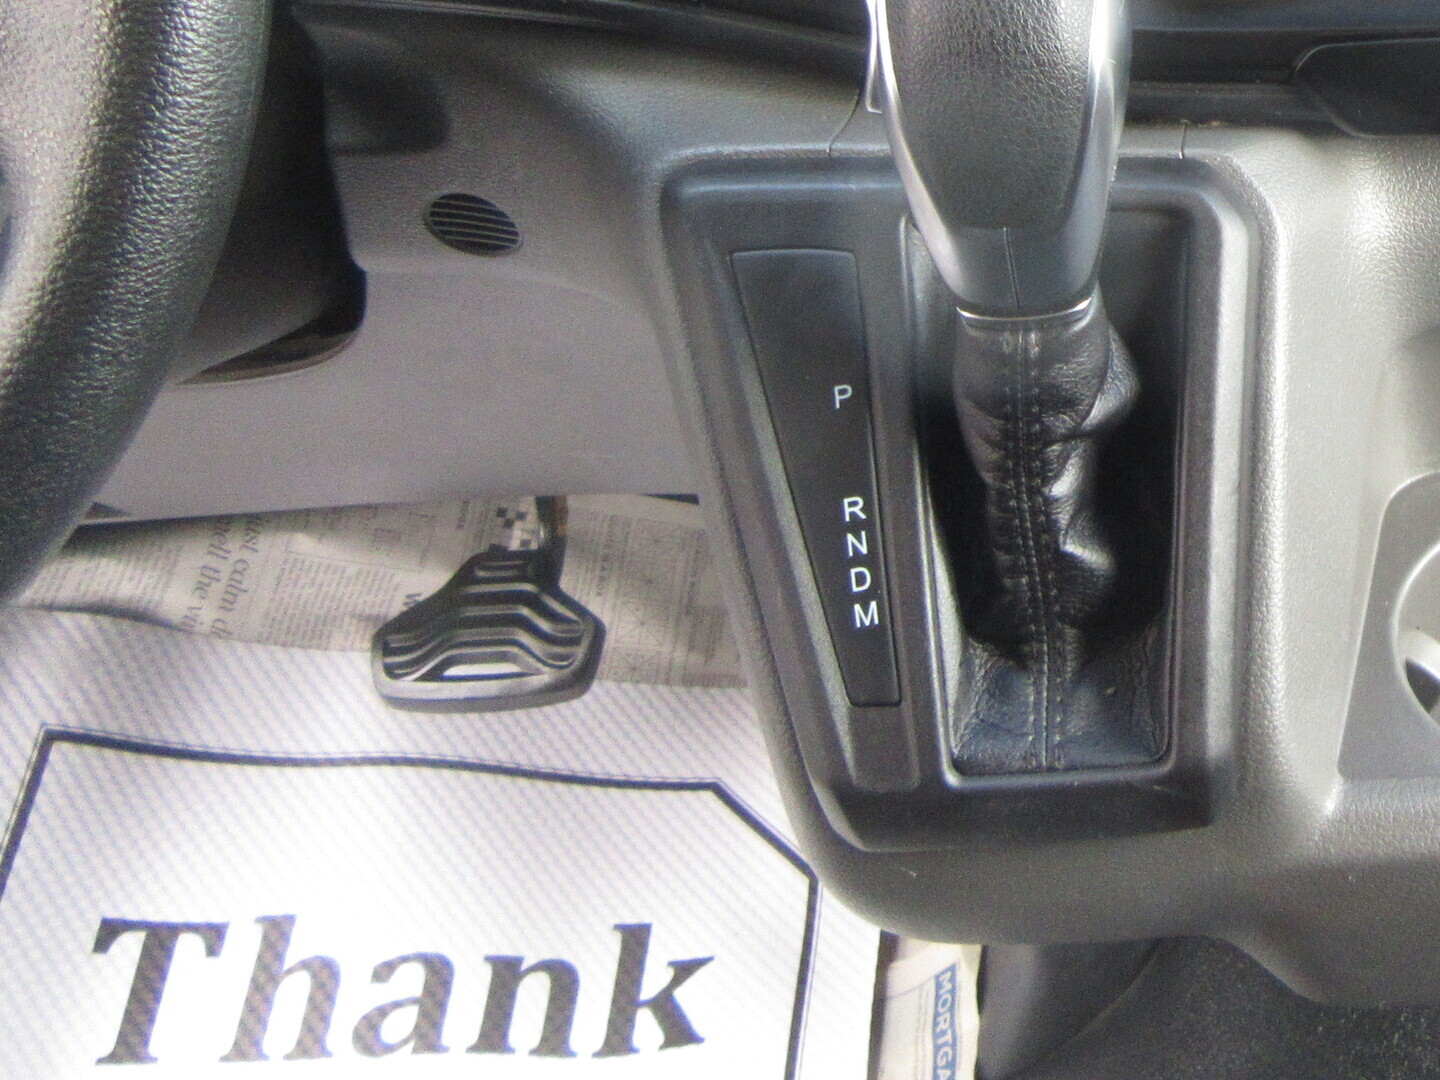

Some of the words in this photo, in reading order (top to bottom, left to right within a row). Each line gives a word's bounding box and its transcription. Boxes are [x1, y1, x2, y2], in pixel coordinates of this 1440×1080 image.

[833, 384, 854, 410] P
[842, 495, 868, 522] R
[846, 530, 869, 557] N
[850, 565, 872, 593] D
[853, 600, 880, 629] M
[92, 914, 716, 1068] Thank
